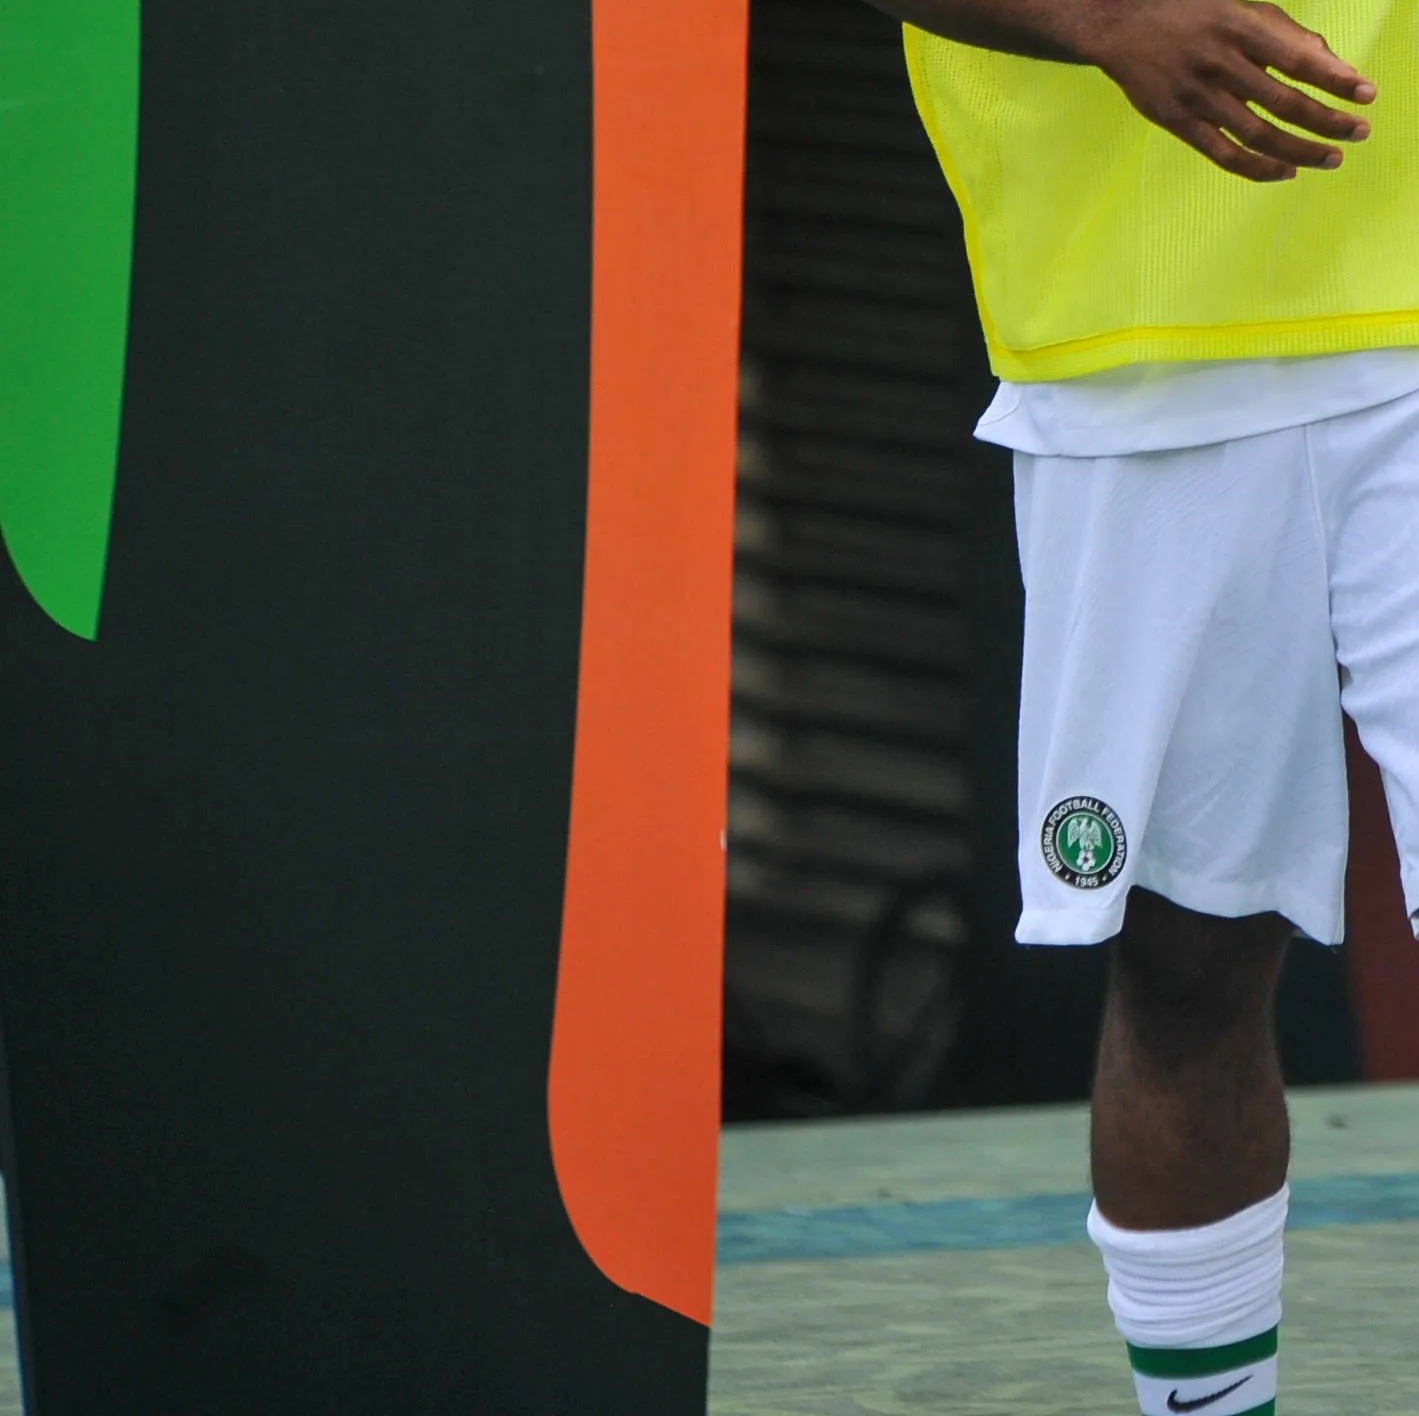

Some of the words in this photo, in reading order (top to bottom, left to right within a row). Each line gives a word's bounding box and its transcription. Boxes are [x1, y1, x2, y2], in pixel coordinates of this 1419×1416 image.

[1048, 799, 1100, 825] FOOTBALL
[1043, 825, 1063, 873] NIGERIA
[1101, 807, 1125, 876] FEDERATION
[1074, 876, 1099, 888] 1945
